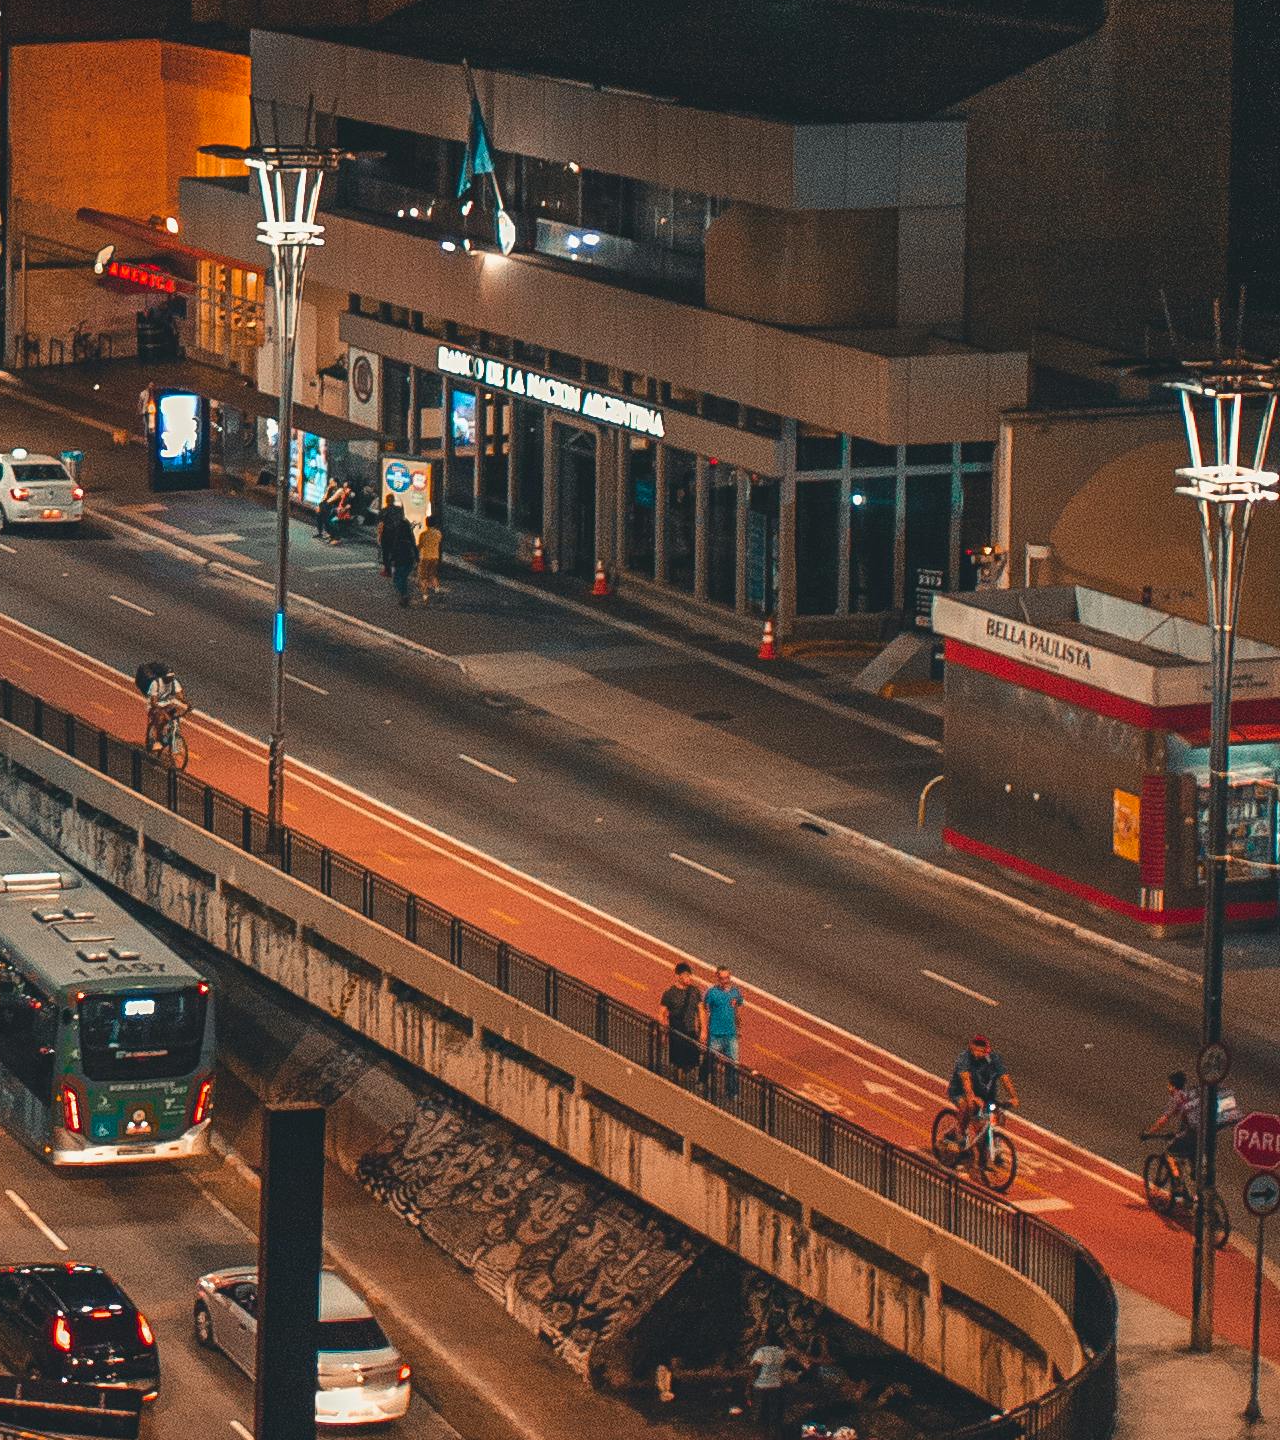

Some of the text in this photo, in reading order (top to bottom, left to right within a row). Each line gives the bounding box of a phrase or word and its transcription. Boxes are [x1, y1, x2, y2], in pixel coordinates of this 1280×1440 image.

[486, 360, 505, 387] DE
[506, 366, 526, 394] LA
[986, 617, 1027, 649] BELLA
[1029, 632, 1092, 671] PAULISTA
